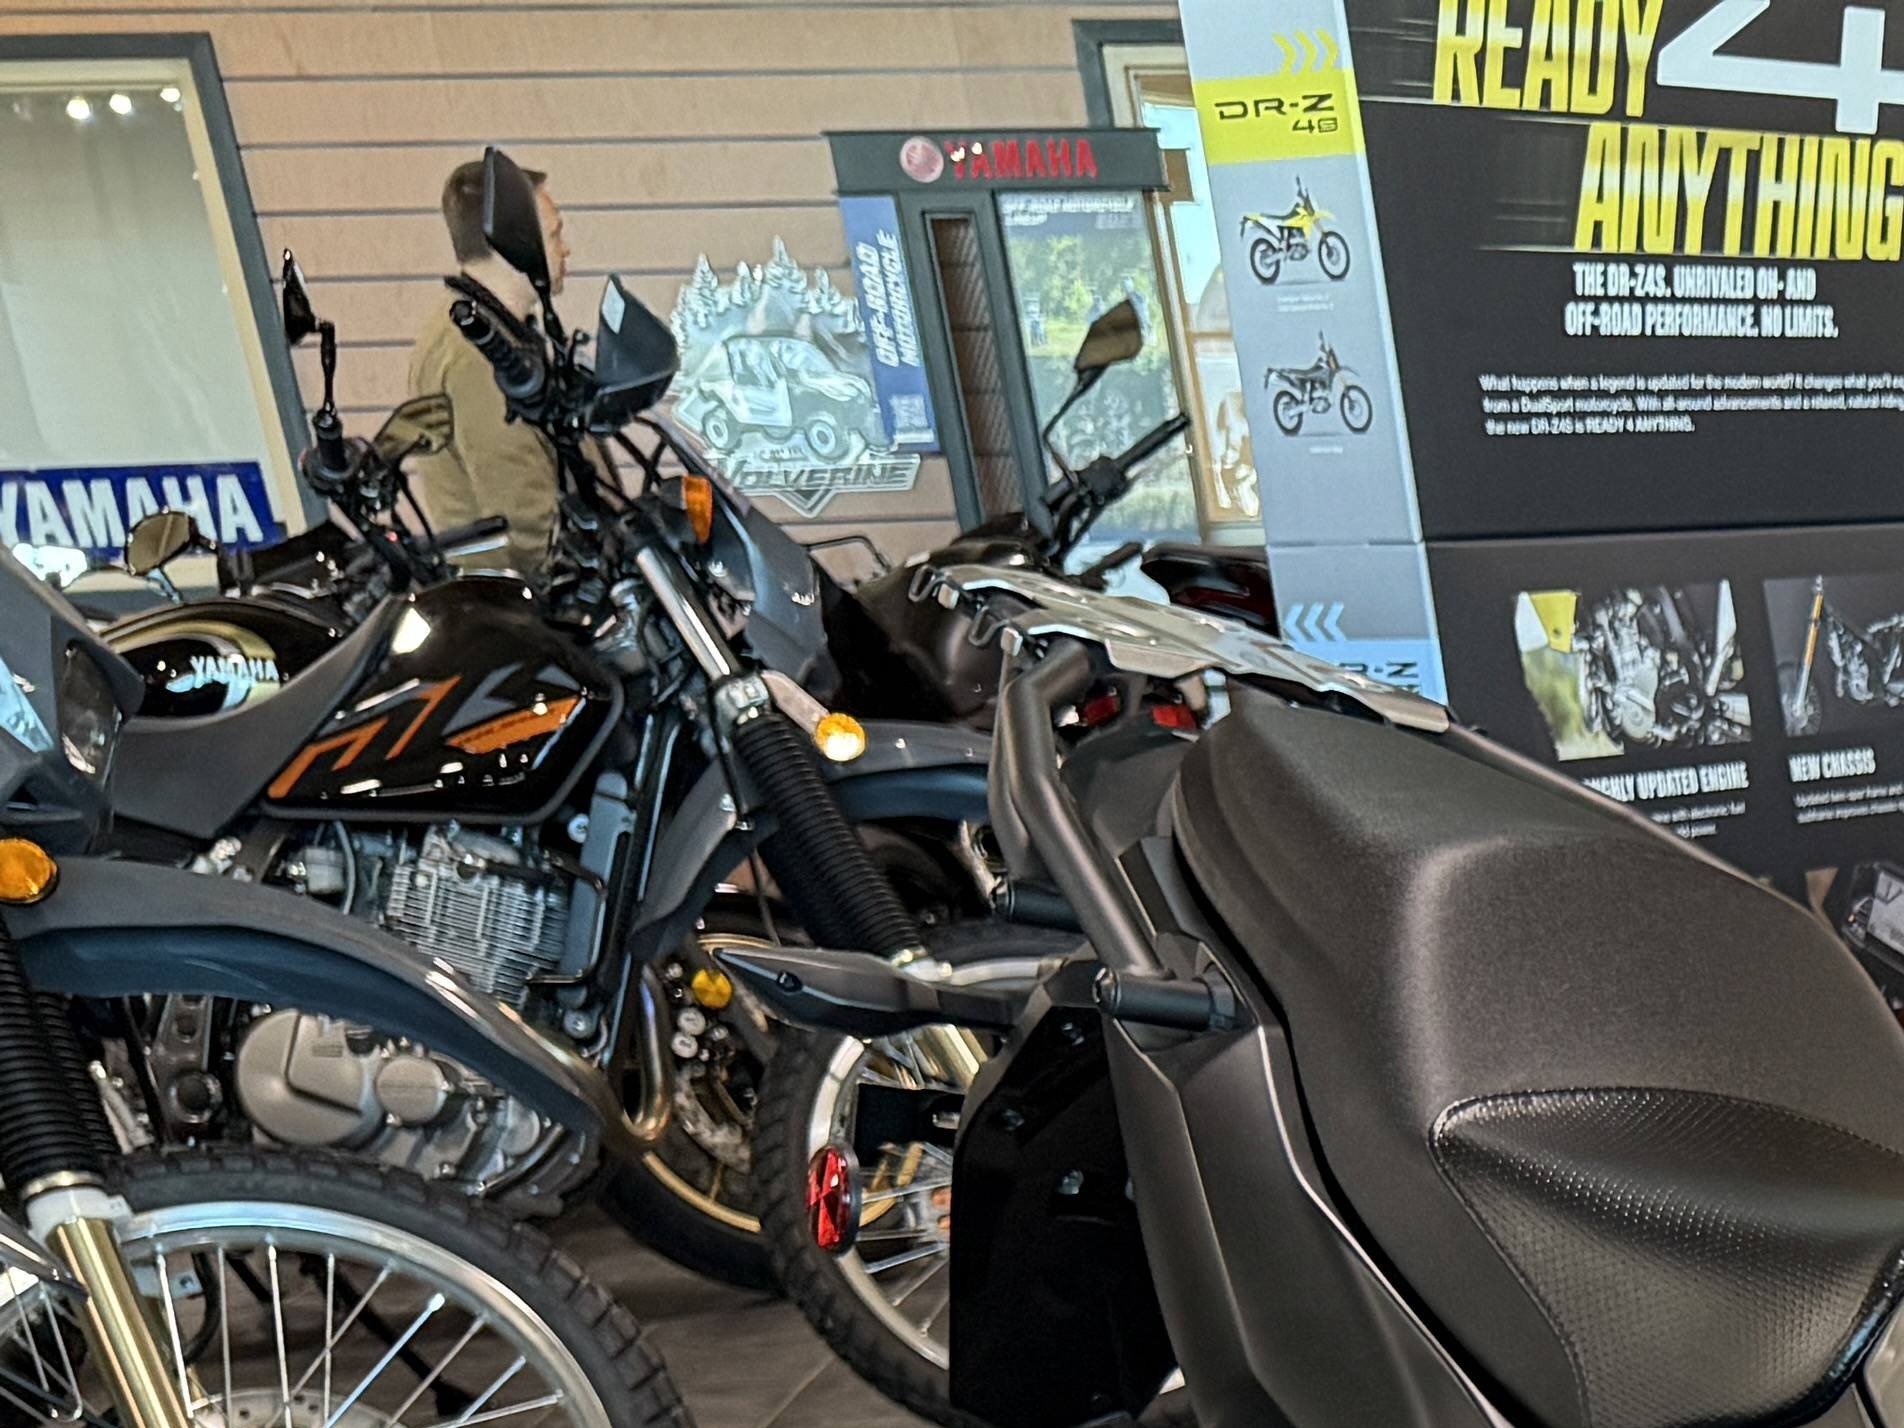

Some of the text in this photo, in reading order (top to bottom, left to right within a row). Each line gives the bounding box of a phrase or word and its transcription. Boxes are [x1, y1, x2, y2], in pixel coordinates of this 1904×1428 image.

[1433, 0, 1663, 117] READY
[1214, 93, 1334, 120] DR-Z
[944, 137, 1098, 180] YAMAHA
[876, 228, 920, 368] MOTORCYCLE
[1573, 261, 1605, 297] THE
[1673, 264, 1755, 299] UNRIVALED
[1785, 267, 1816, 300] AND
[856, 240, 900, 368] OFF-ROAD
[1564, 301, 1643, 337] OFF-ROAD
[1644, 302, 1759, 338] PERFORMANCE.
[1760, 304, 1783, 338] NO
[1585, 415, 1625, 434] READY
[189, 655, 280, 688] YAMAHA
[1338, 662, 1420, 679] R-Z
[1635, 765, 1699, 800] UPDATED
[1699, 760, 1750, 793] ENGINE
[1788, 746, 1876, 783] NEW CHASSIS
